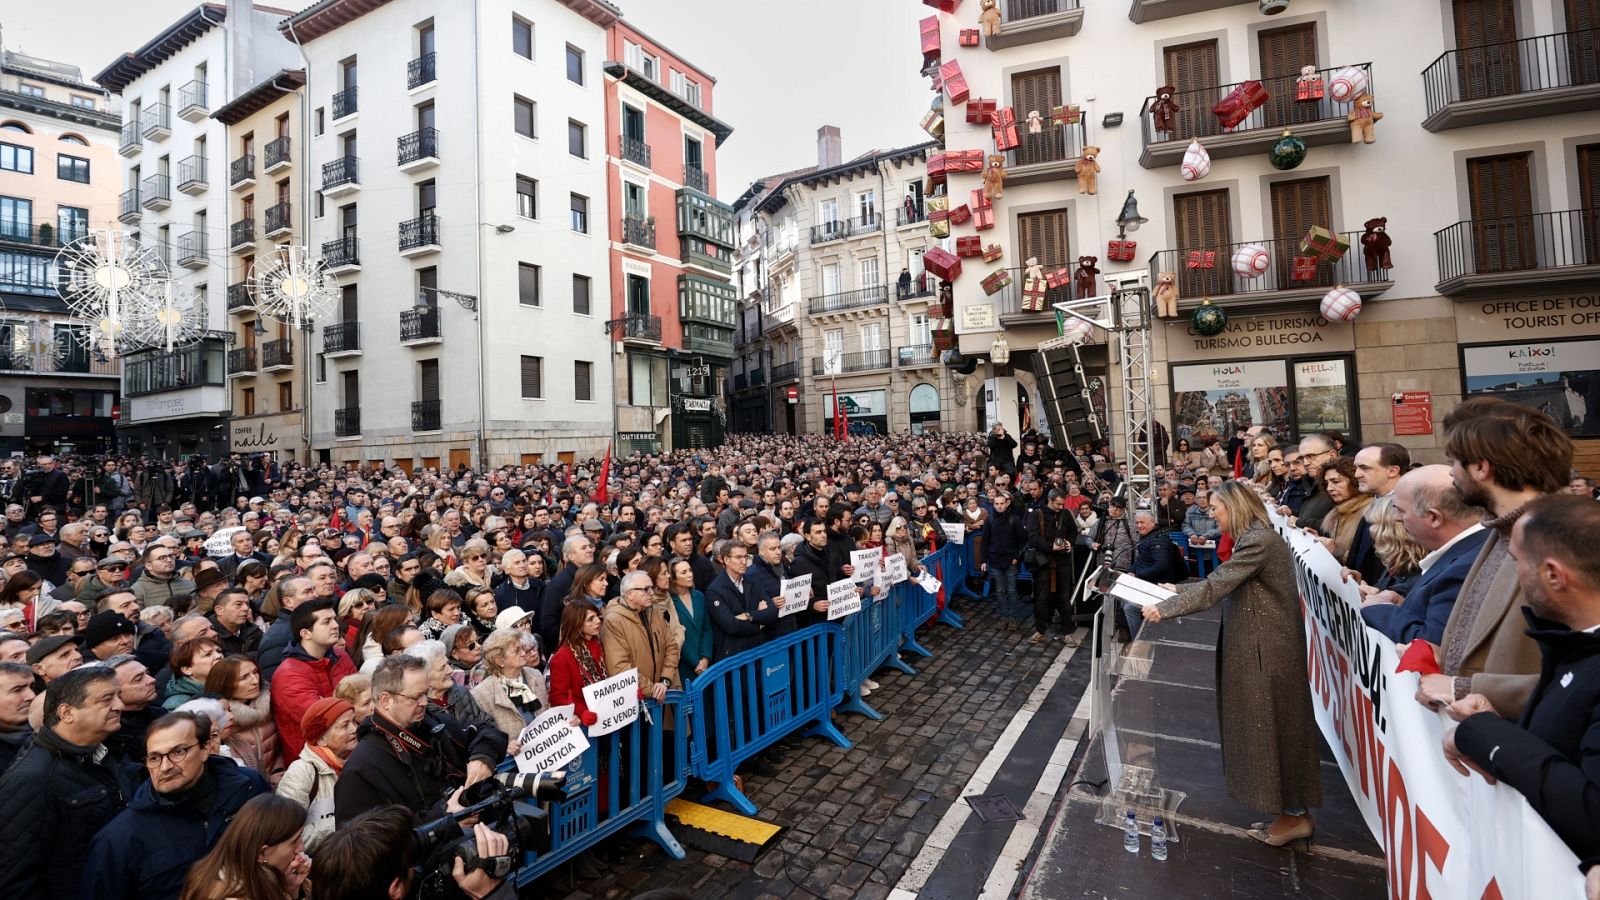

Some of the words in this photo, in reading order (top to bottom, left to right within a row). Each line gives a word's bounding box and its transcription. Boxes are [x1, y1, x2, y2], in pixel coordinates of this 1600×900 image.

[1482, 300, 1538, 315] OFFICE
[1543, 299, 1564, 311] DE
[1247, 321, 1265, 332] DE
[1268, 315, 1328, 330] TURISMO
[1503, 314, 1566, 329] TOURIST
[1193, 336, 1252, 350] TURISMO
[1256, 332, 1323, 346] BULEGOA
[234, 422, 278, 447] nails
[785, 578, 811, 591] PAMPLONA
[794, 591, 802, 599] NO
[791, 600, 807, 610] VENDE
[593, 675, 637, 700] PAMPLONA
[612, 696, 625, 708] NO
[602, 717, 612, 729] SE
[613, 706, 637, 725] VENDE
[520, 712, 568, 746] MEMORIA,
[398, 731, 422, 749] Canon
[524, 727, 573, 760] DIGNIDAD,
[535, 742, 576, 773] JUSTICIA
